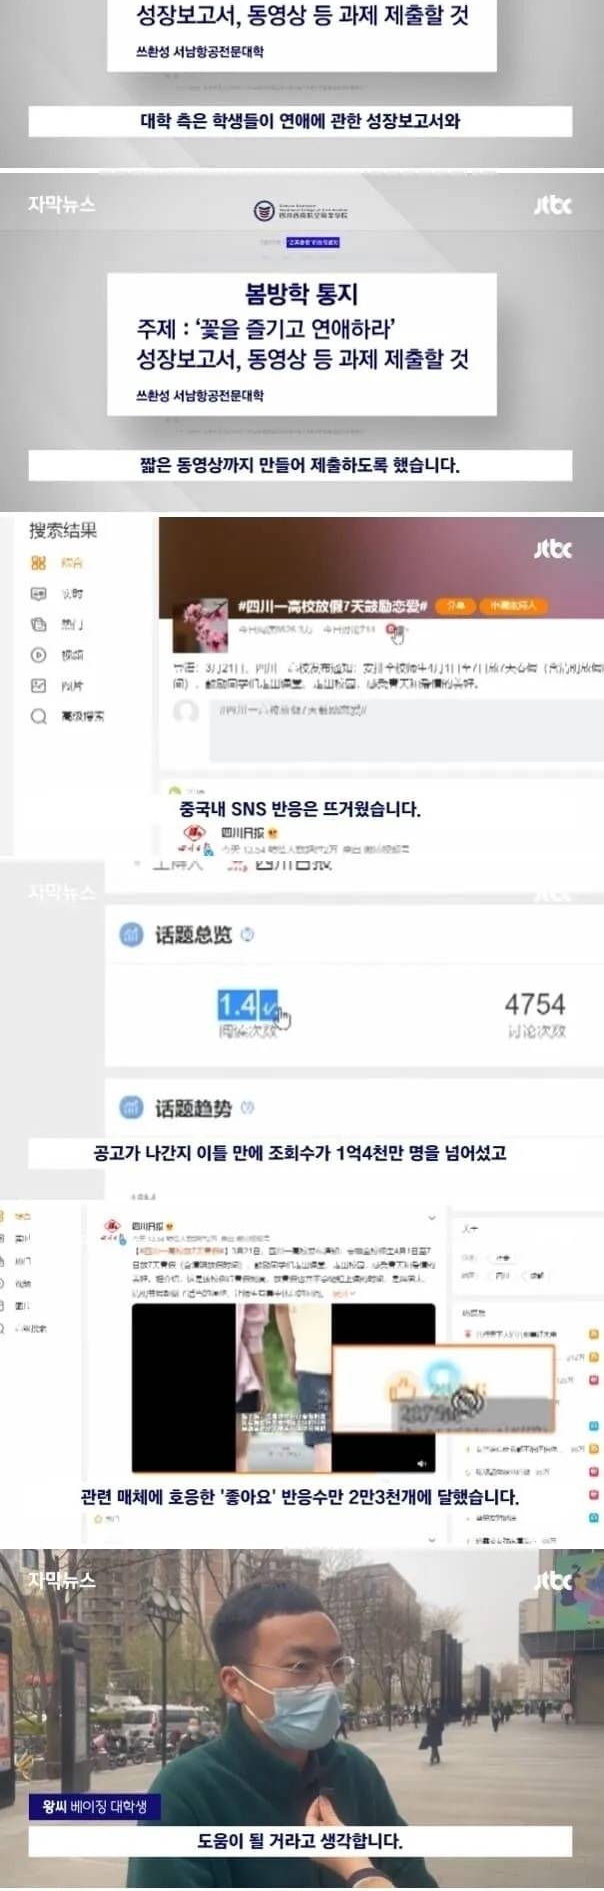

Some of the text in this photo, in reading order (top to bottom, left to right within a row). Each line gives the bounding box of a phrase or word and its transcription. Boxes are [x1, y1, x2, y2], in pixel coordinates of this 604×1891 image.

[29, 521, 98, 540] 搜索结果
[155, 924, 233, 945] 话题总览
[504, 992, 567, 1016] 4754
[155, 1098, 233, 1119] 话题趋势
